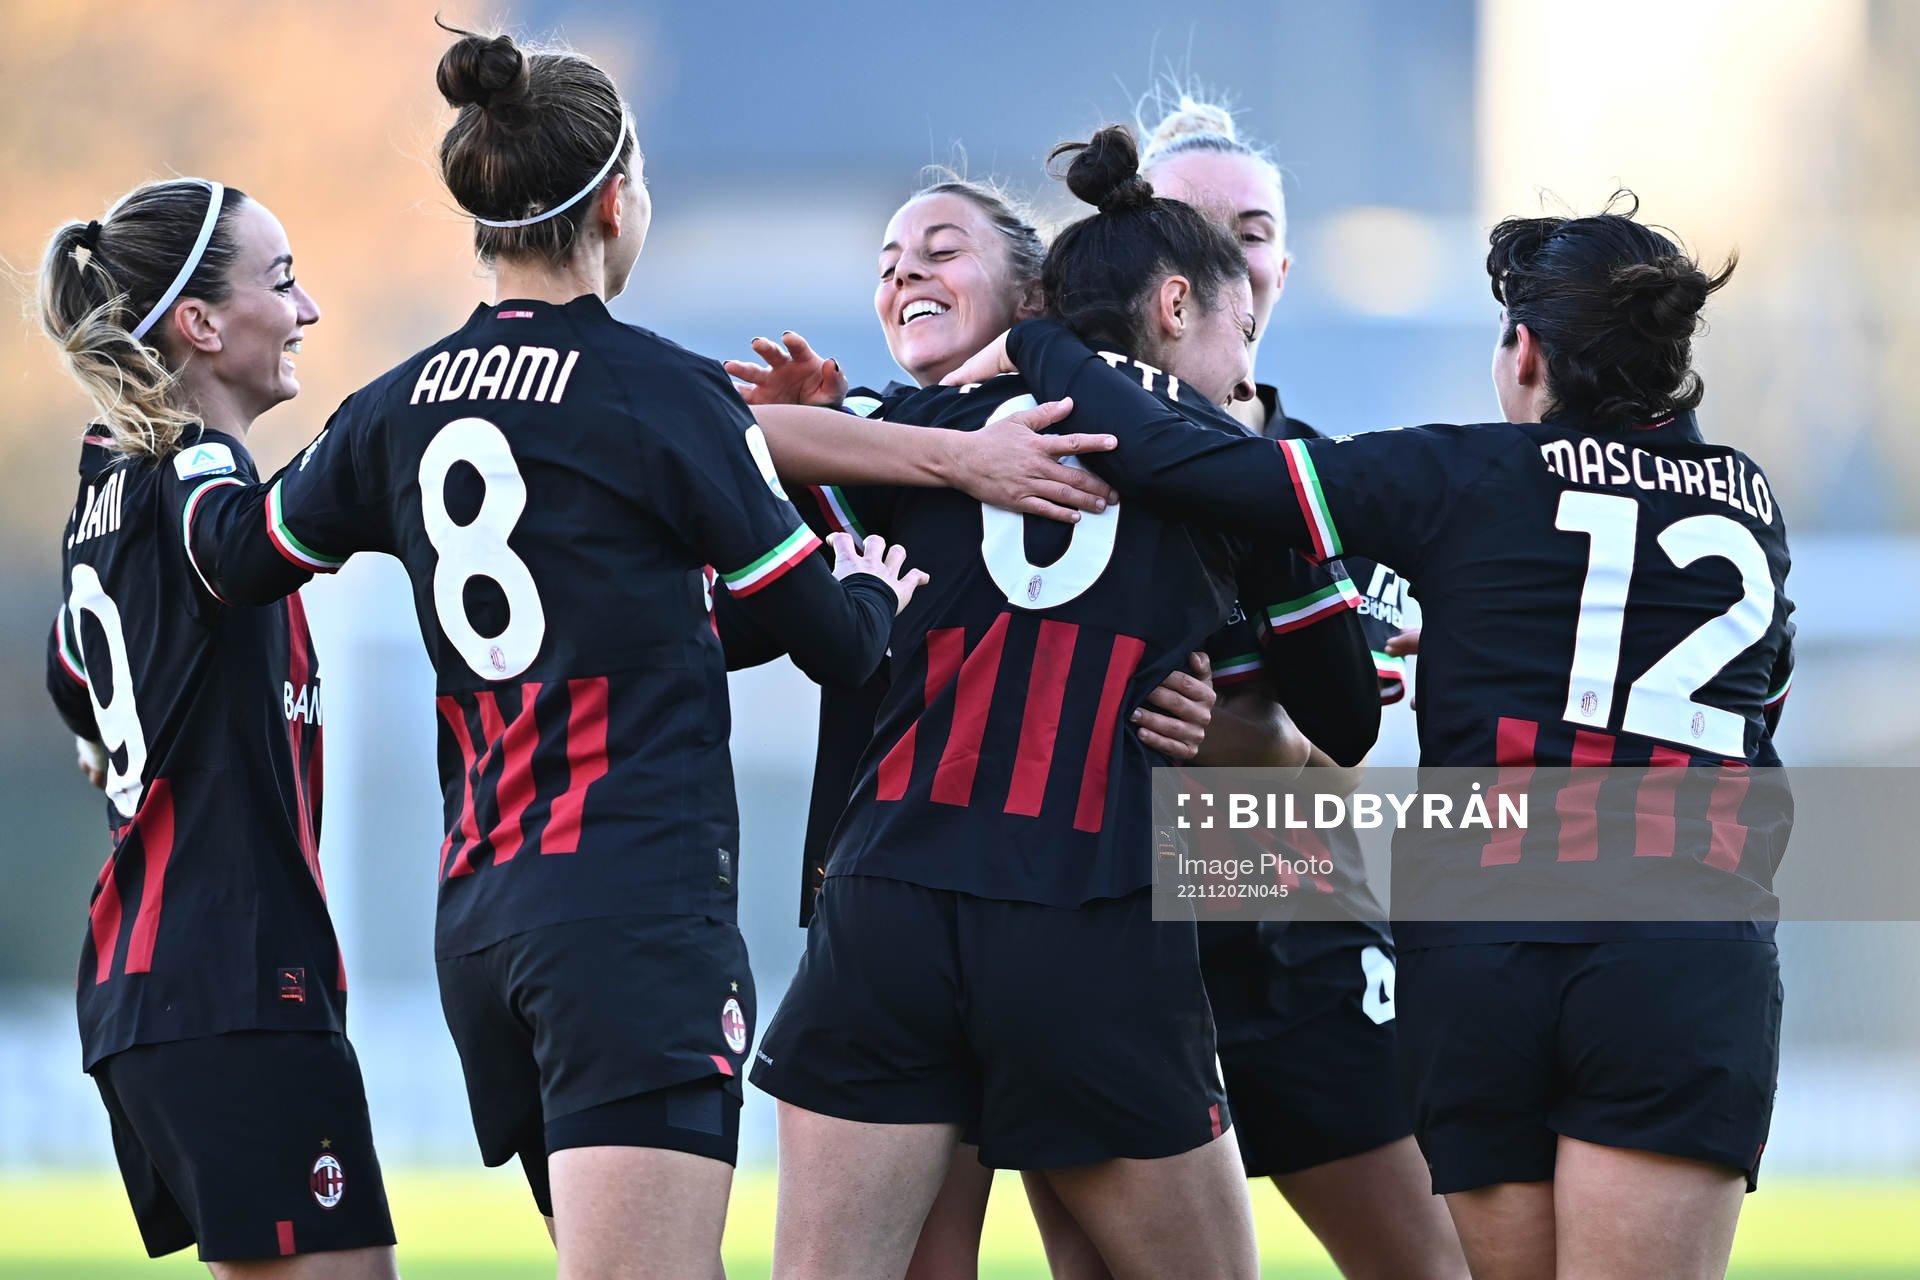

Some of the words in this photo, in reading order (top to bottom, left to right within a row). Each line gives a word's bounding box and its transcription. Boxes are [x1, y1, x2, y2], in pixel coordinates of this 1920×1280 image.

[410, 344, 580, 405] ADAMI
[1541, 437, 1773, 526] MASCARELLO
[418, 417, 546, 682] 8
[1555, 490, 1775, 759] 12
[68, 563, 147, 818] 9
